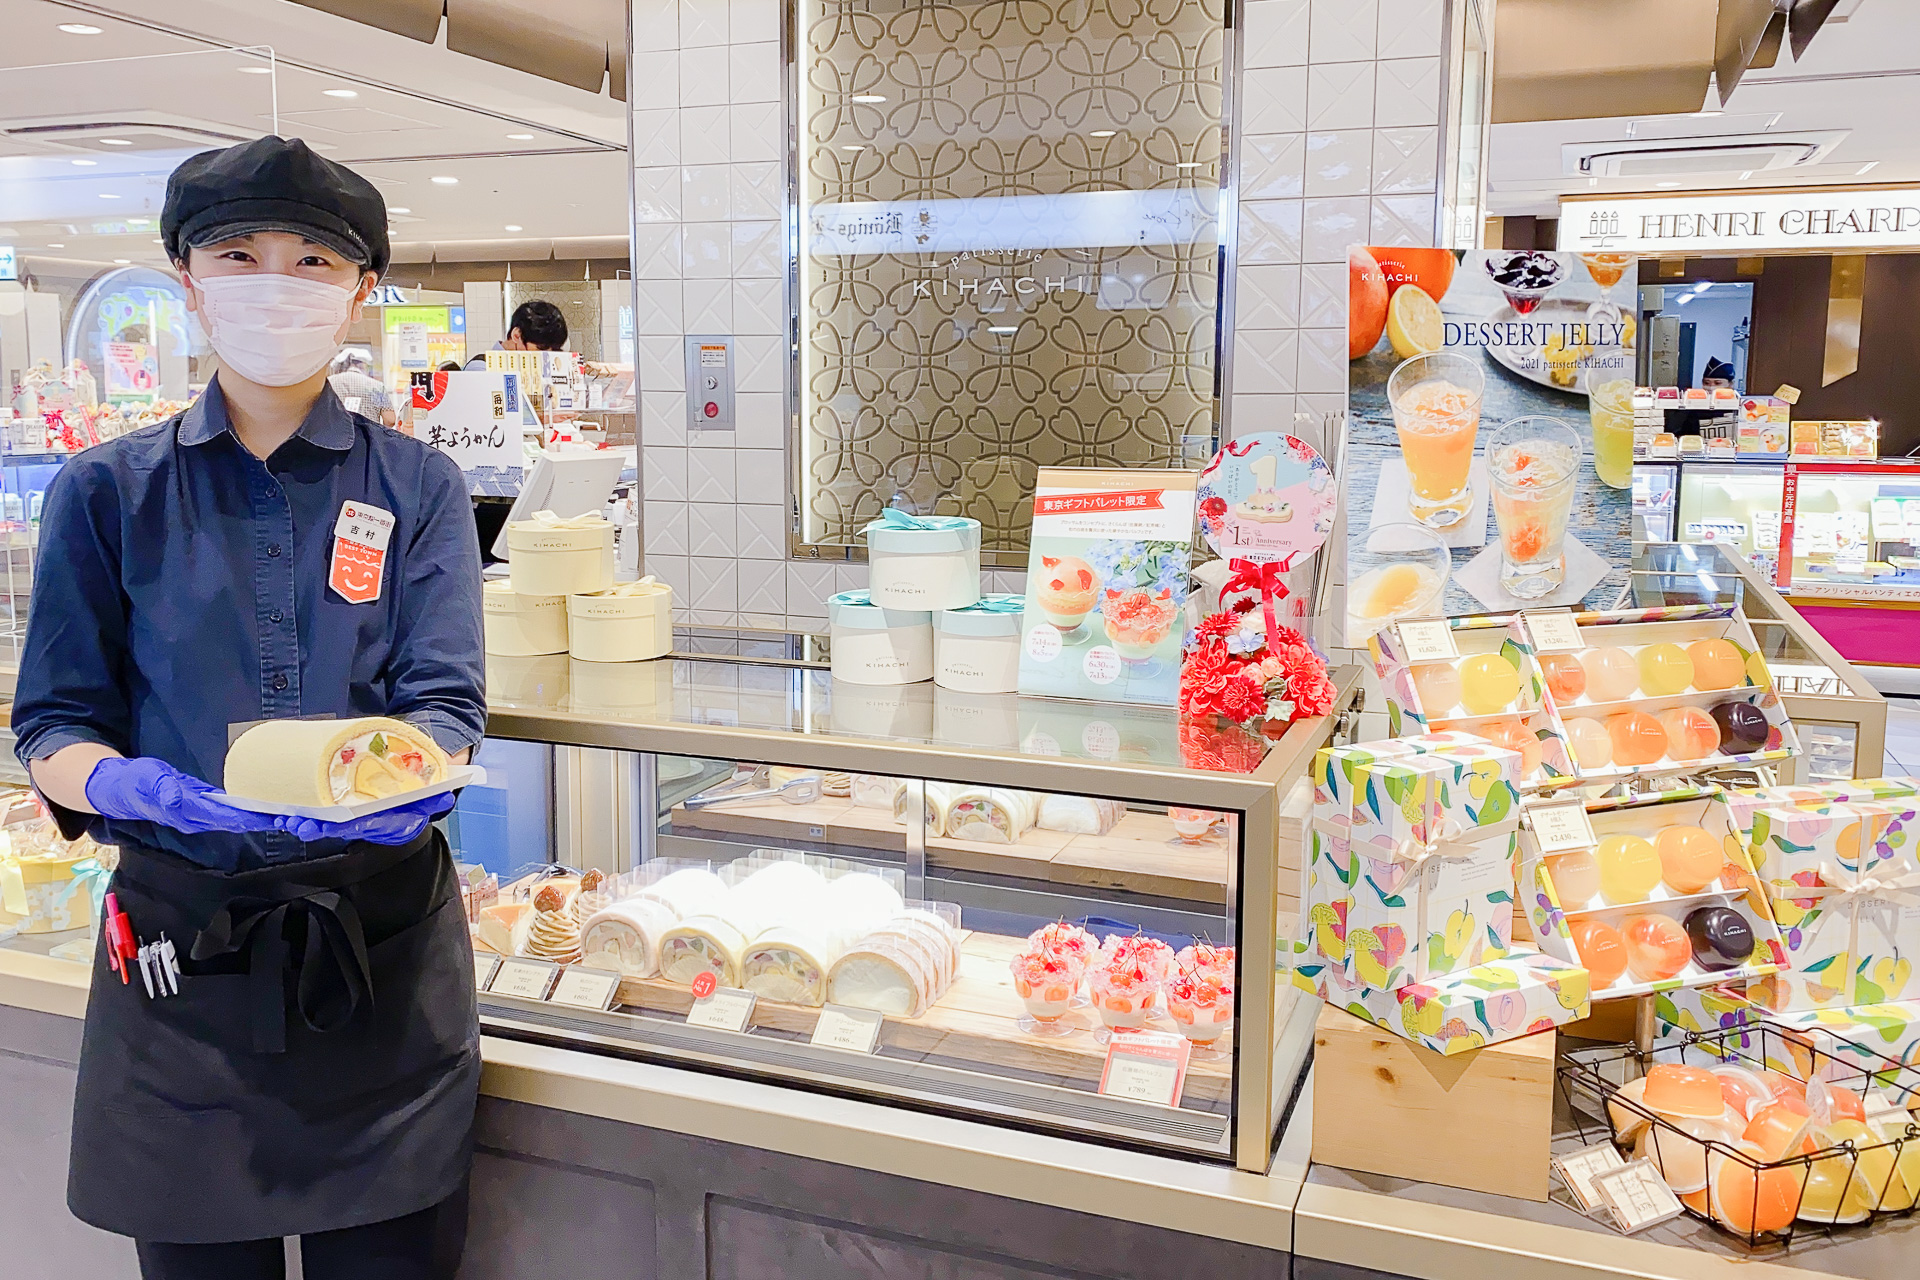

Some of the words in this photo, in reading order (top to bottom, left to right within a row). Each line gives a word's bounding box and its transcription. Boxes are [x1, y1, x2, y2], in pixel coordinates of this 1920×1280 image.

[1638, 211, 1765, 239] HENRI
[1779, 207, 1920, 236] CHARP
[951, 245, 1043, 270] patisserie
[1361, 272, 1419, 282] KIHACHI
[912, 274, 1084, 298] KIHACHI
[1443, 322, 1553, 347] DESSERT
[1558, 322, 1626, 352] JELLY
[1520, 358, 1539, 370] 2021
[1543, 358, 1582, 371] patisserie
[1584, 357, 1625, 369] KIHACHI
[428, 424, 505, 449] 芋ようかん
[1043, 494, 1147, 511] 東京ギフトパレット限定
[344, 544, 359, 552] BEST
[1256, 537, 1292, 548] Anniversary
[884, 587, 926, 595] KIHACHI
[1815, 586, 1920, 598] アンリ・シャルパンティエの
[944, 667, 985, 677] KIHACHI
[1550, 833, 1572, 842] ¥2,430
[1128, 1085, 1146, 1093] ¥789
